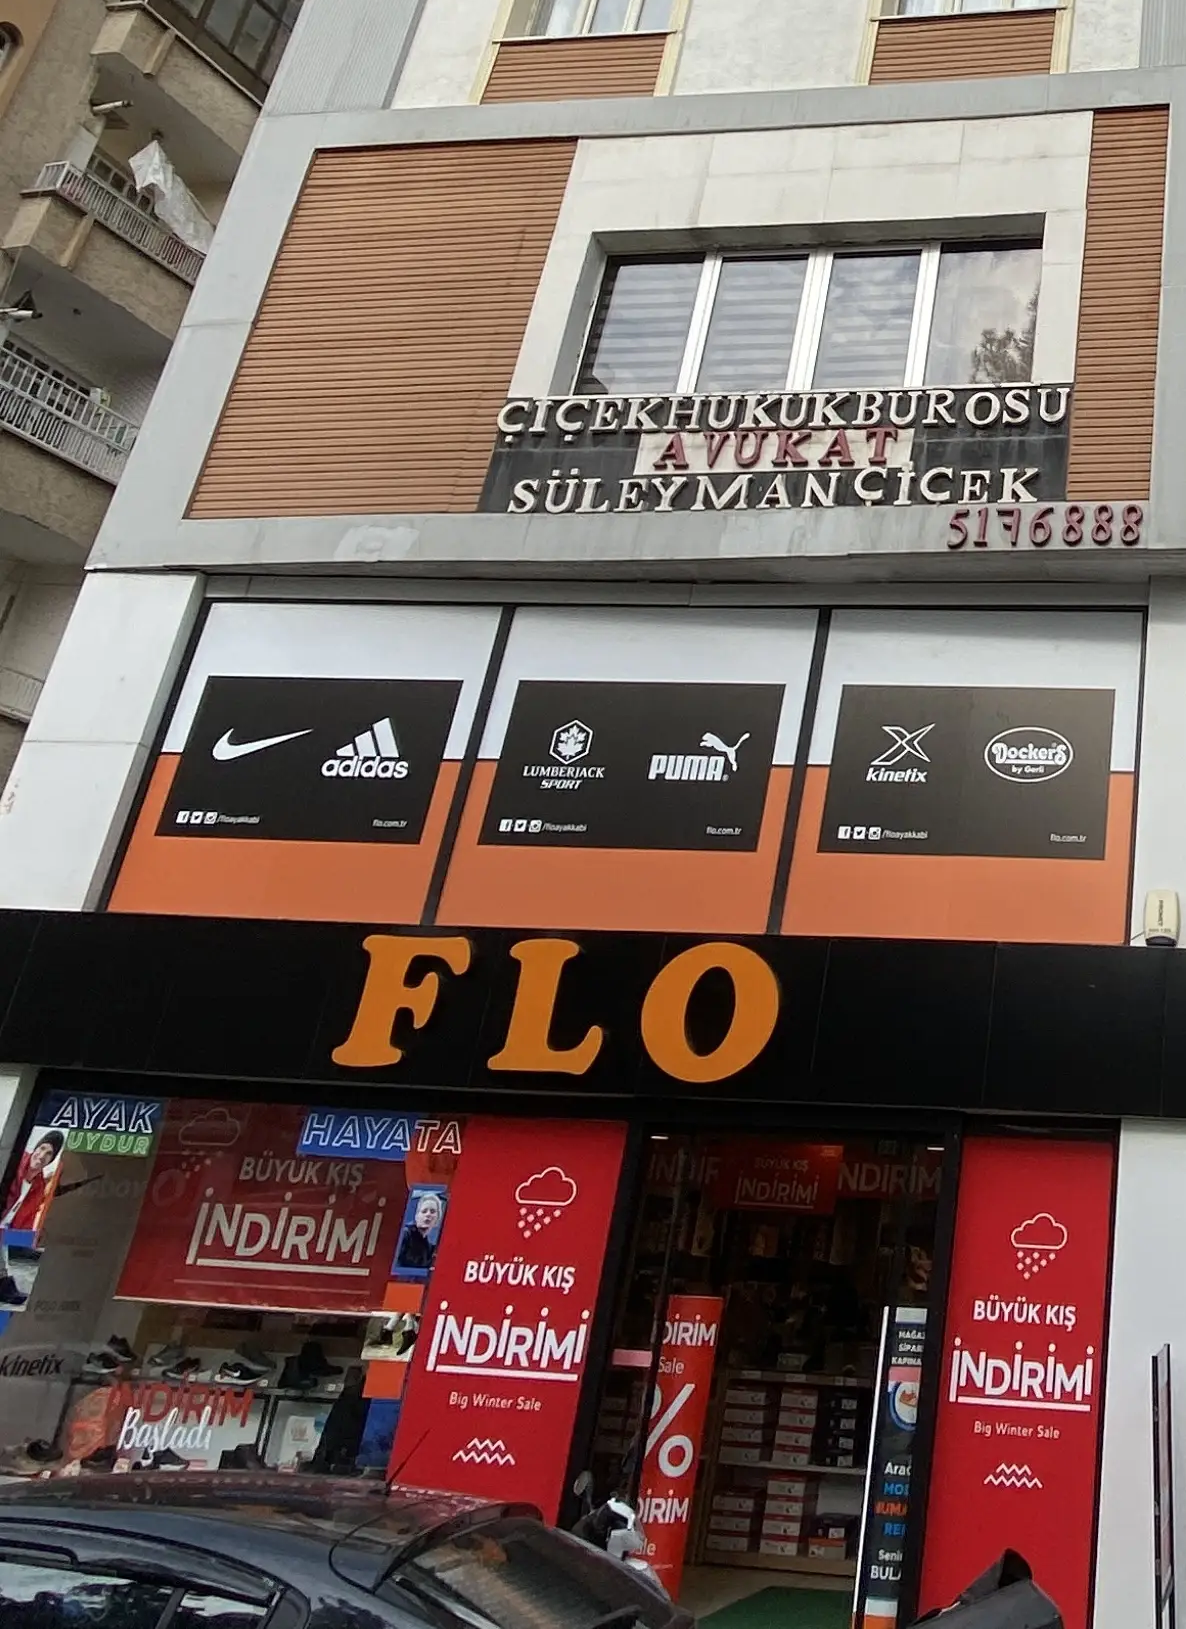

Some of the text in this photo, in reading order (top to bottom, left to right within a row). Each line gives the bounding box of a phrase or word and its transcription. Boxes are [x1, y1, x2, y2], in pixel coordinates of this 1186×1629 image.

[653, 427, 898, 469] AVUKAT
[507, 468, 841, 514] SÜLEYMAN
[947, 504, 1144, 548] 5176888
[321, 755, 408, 779] adidas
[522, 765, 605, 779] LUMBERJACK
[539, 779, 582, 790] SPORT
[648, 754, 726, 781] PUMA
[866, 767, 928, 783] kinetix
[1012, 765, 1022, 774] by
[706, 825, 742, 836] flo.com.tr
[331, 934, 780, 1083] FLO
[50, 1096, 161, 1134] AYAK
[302, 1113, 462, 1155] HAYATA
[66, 1130, 151, 1156] UYDUR
[238, 1150, 364, 1194] BÜYÜK KIŞ
[185, 1186, 387, 1265] İNDİRİMİ
[463, 1254, 576, 1294] BÜYÜK KIŞ
[973, 1294, 1076, 1332] BÜYÜK KIŞ
[425, 1300, 591, 1372] İNDİRİMİ
[0, 1353, 65, 1377] kinetix
[658, 1356, 685, 1374] Sale
[949, 1336, 1095, 1403] İNDİRİMİ
[449, 1391, 543, 1411] Big Winter Sale
[116, 1404, 214, 1466] Başladı
[974, 1420, 1061, 1439] Big Winter Sale
